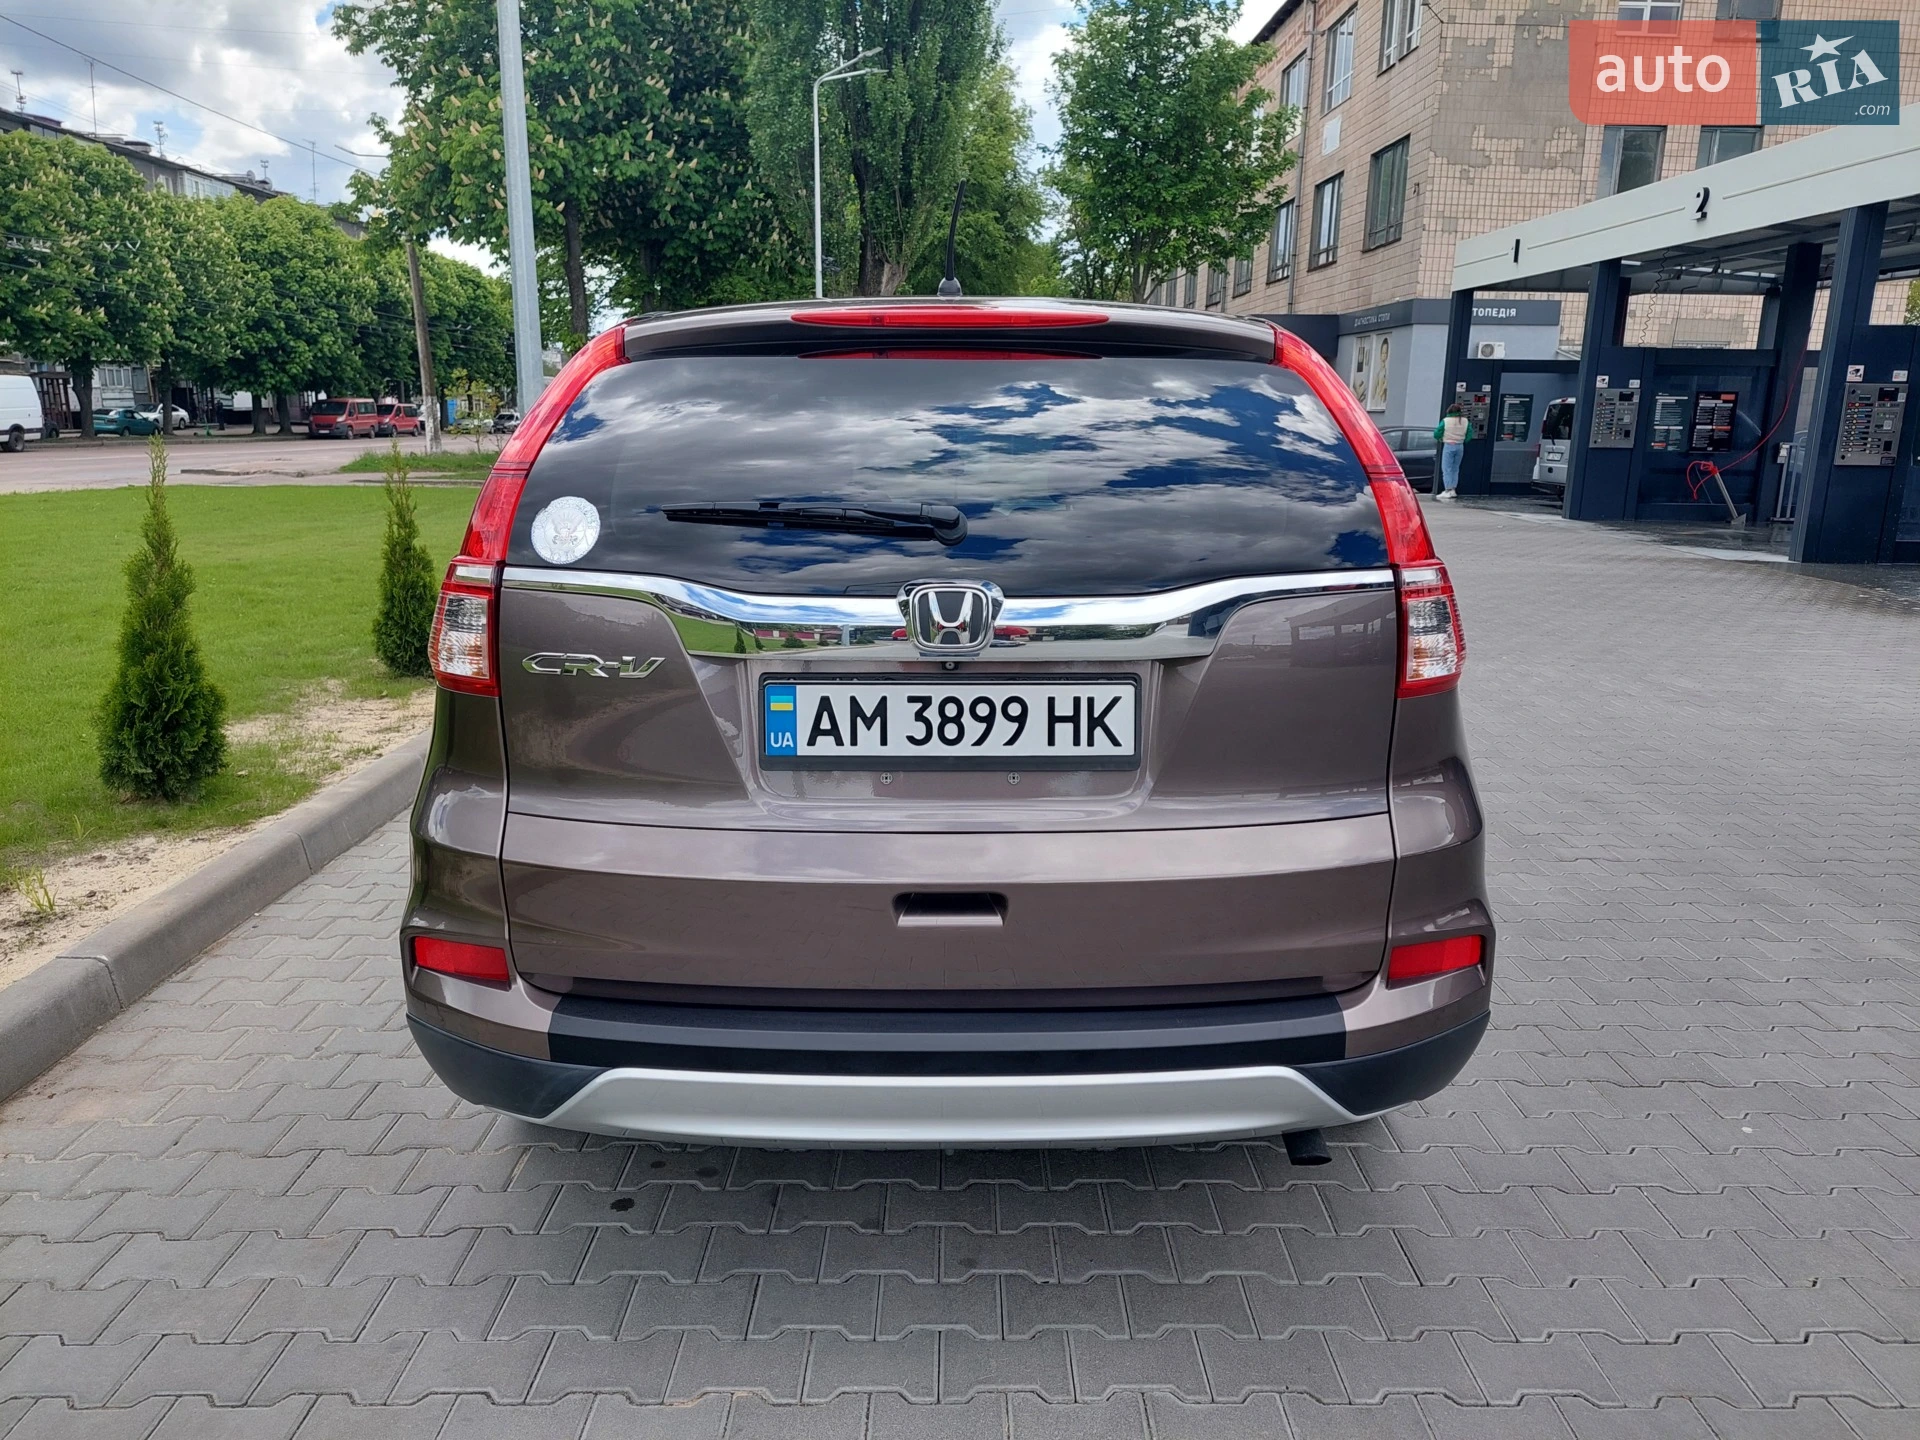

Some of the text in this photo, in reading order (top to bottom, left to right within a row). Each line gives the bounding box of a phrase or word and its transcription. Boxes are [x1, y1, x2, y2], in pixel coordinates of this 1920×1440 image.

[1695, 187, 1710, 220] 2
[522, 652, 666, 679] CR-V
[806, 695, 1123, 747] AM 3899 HK
[770, 732, 794, 748] UA
